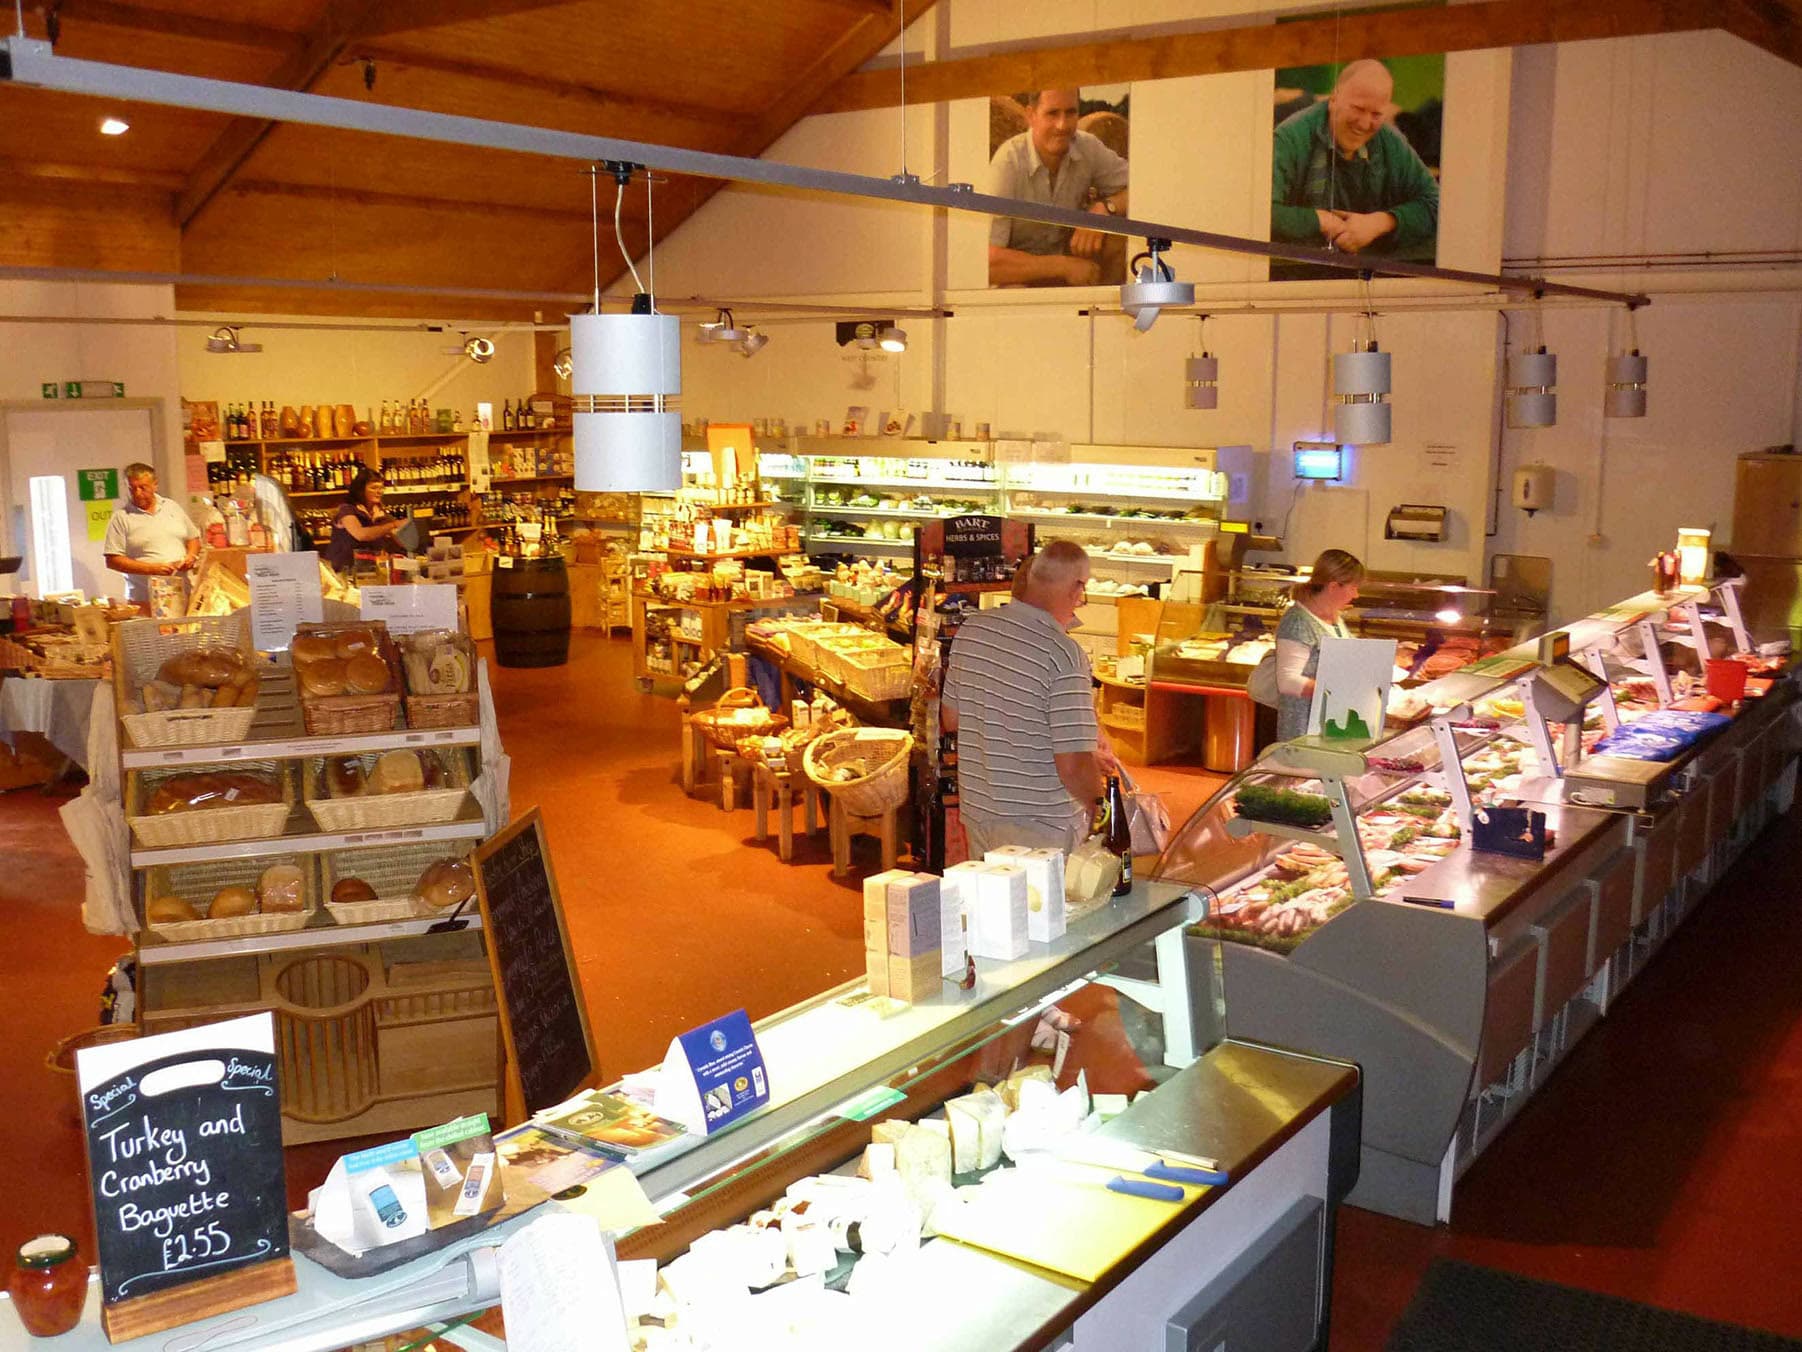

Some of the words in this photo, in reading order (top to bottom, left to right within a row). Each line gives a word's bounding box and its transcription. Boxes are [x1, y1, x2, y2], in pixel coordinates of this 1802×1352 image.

[87, 471, 109, 480] EXIT
[92, 511, 111, 520] OUT
[955, 518, 991, 528] BART
[946, 534, 967, 542] HERBS
[969, 534, 975, 542] &
[976, 533, 1000, 542] SPICES
[226, 1057, 273, 1081] Special
[90, 1076, 137, 1111] Special
[99, 1115, 187, 1166] Turkey
[199, 1103, 246, 1137] and
[101, 1159, 210, 1197] Cranberry
[119, 1191, 230, 1238] Baguette
[163, 1221, 231, 1271] £2.55
